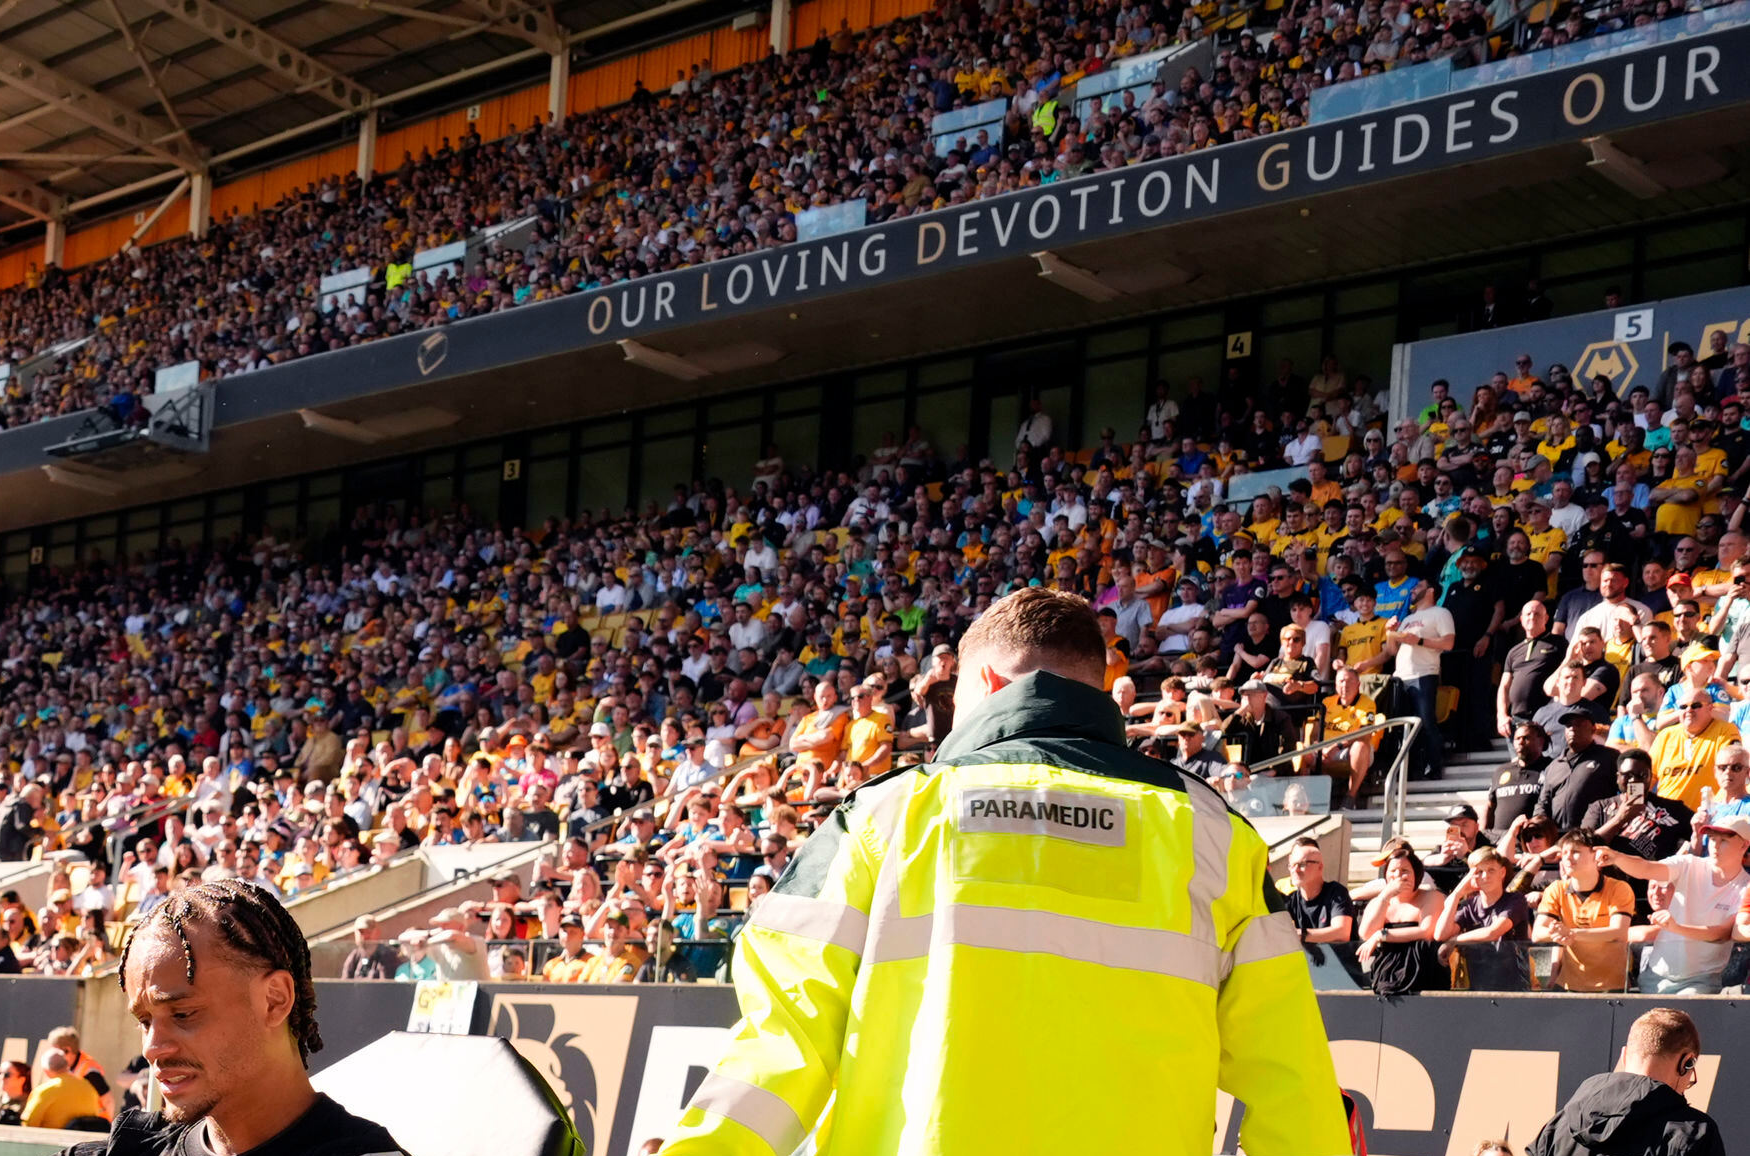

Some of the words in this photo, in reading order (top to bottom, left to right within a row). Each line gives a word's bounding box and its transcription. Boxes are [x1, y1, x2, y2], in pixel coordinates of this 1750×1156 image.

[587, 280, 676, 335] OUR
[700, 233, 887, 312] LOVING
[916, 158, 1220, 266] DEVOTION
[1256, 90, 1520, 192] GUIDES
[1562, 44, 1722, 126] OUR
[1624, 314, 1643, 339] 5
[1231, 335, 1245, 355] 4
[507, 462, 516, 478] 3
[1519, 783, 1541, 796] YOR
[969, 798, 1115, 831] PARAMEDIC
